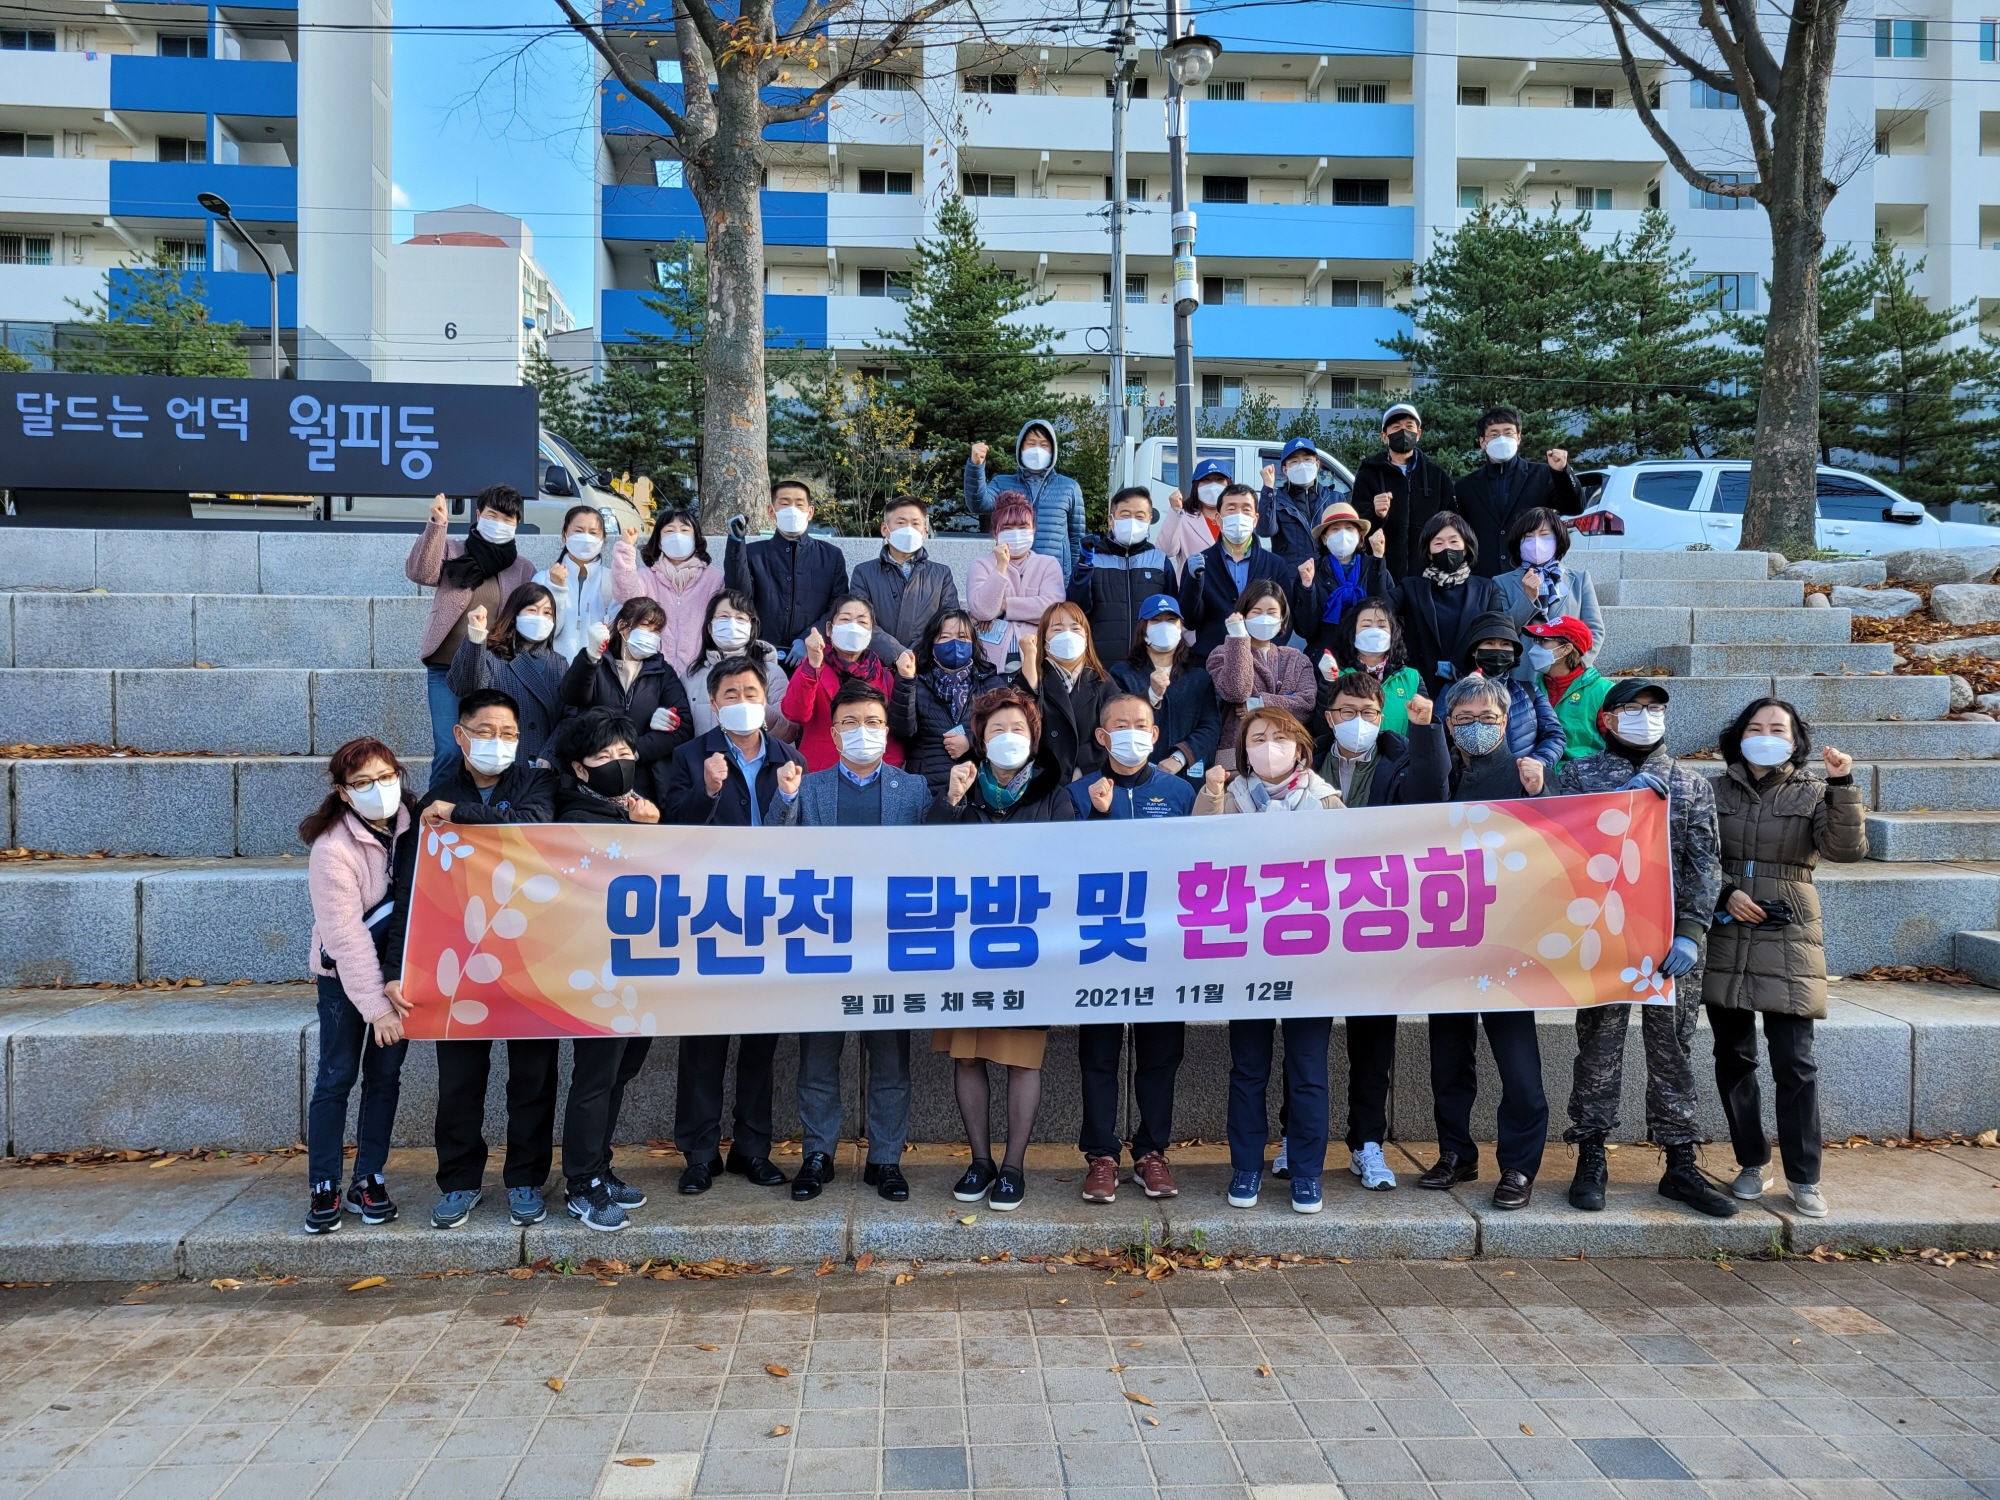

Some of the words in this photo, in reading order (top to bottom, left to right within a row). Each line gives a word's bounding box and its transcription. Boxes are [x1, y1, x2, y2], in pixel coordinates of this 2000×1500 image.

[444, 322, 457, 340] 6
[16, 392, 150, 439] 달드는
[166, 396, 249, 442] 언덕
[289, 394, 440, 480] 월피동
[606, 869, 854, 977] 안산천
[886, 875, 1052, 972] 탐방
[1076, 870, 1148, 966] 및
[1177, 847, 1497, 961] 환경정화
[841, 994, 927, 1016] 월피동
[940, 989, 1025, 1013] 체육회
[1075, 986, 1155, 1008] 2021년
[1175, 983, 1224, 1004] 11월
[1245, 980, 1294, 1002] 12일
